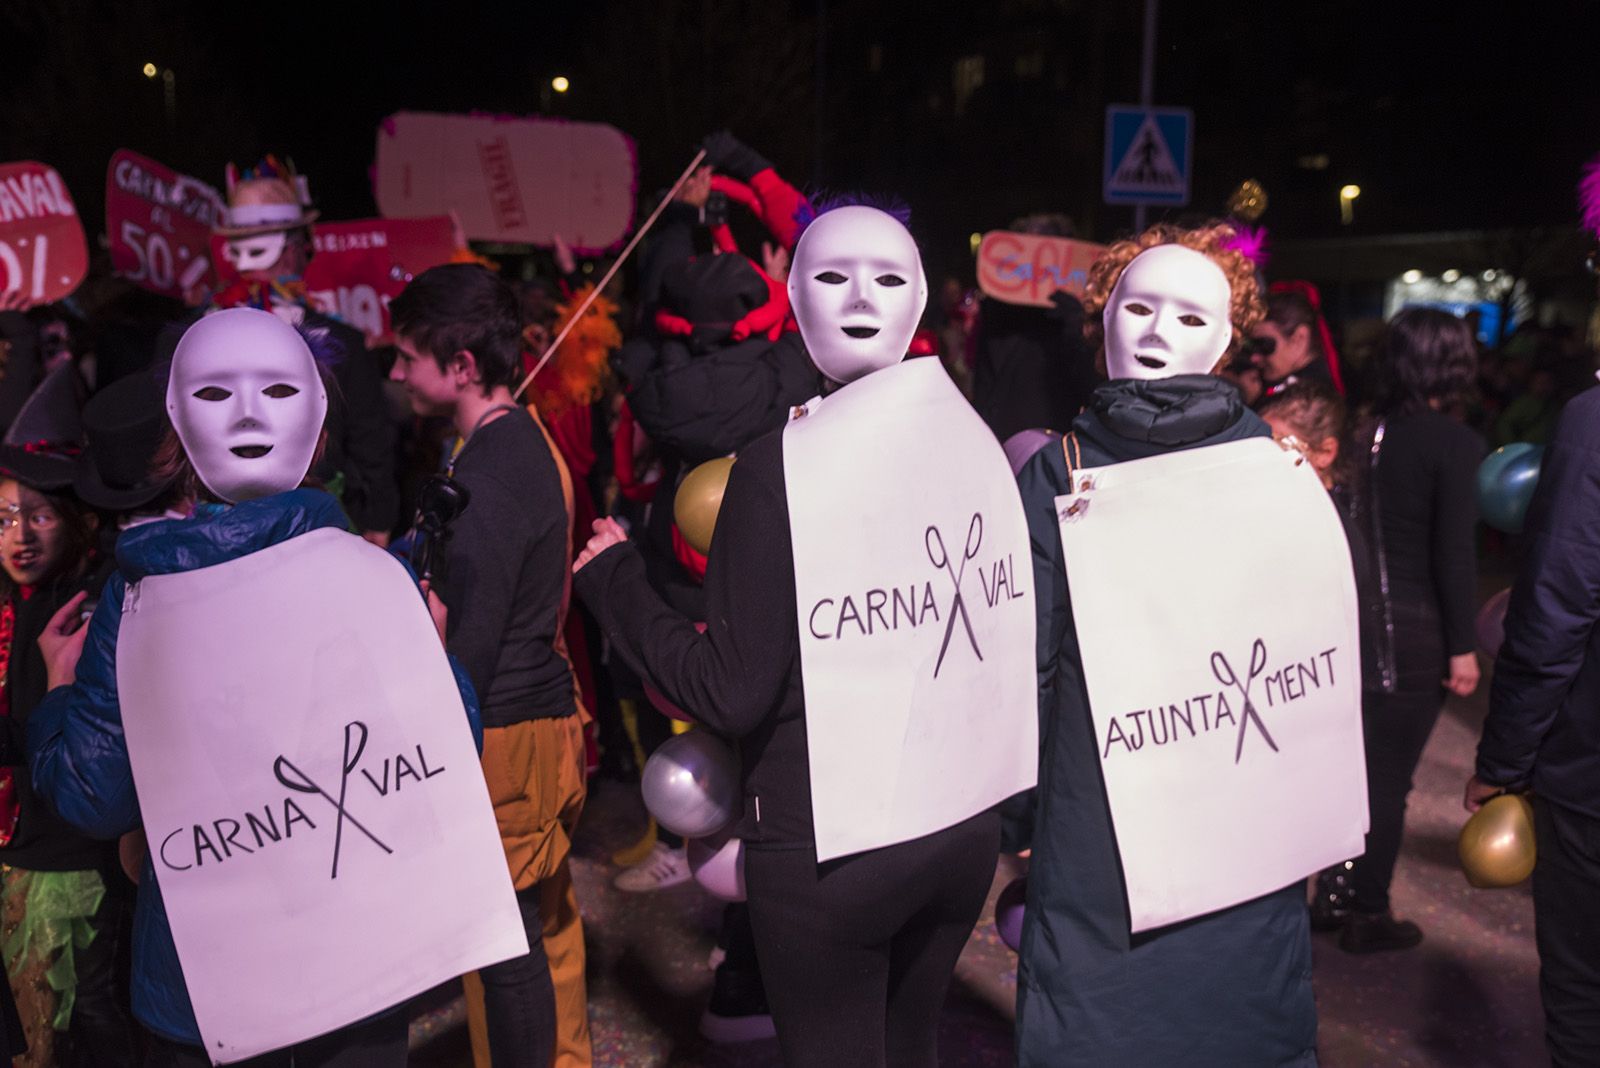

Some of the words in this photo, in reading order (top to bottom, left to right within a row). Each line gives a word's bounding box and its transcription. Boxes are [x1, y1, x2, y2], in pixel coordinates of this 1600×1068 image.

[0, 169, 75, 222] AVAL
[808, 581, 940, 640] CARNA
[978, 553, 1025, 608] VAL
[1103, 691, 1237, 759] AJUNTA
[1264, 647, 1338, 707] MENT
[160, 797, 317, 871] CARNA
[360, 744, 446, 796] VAL
